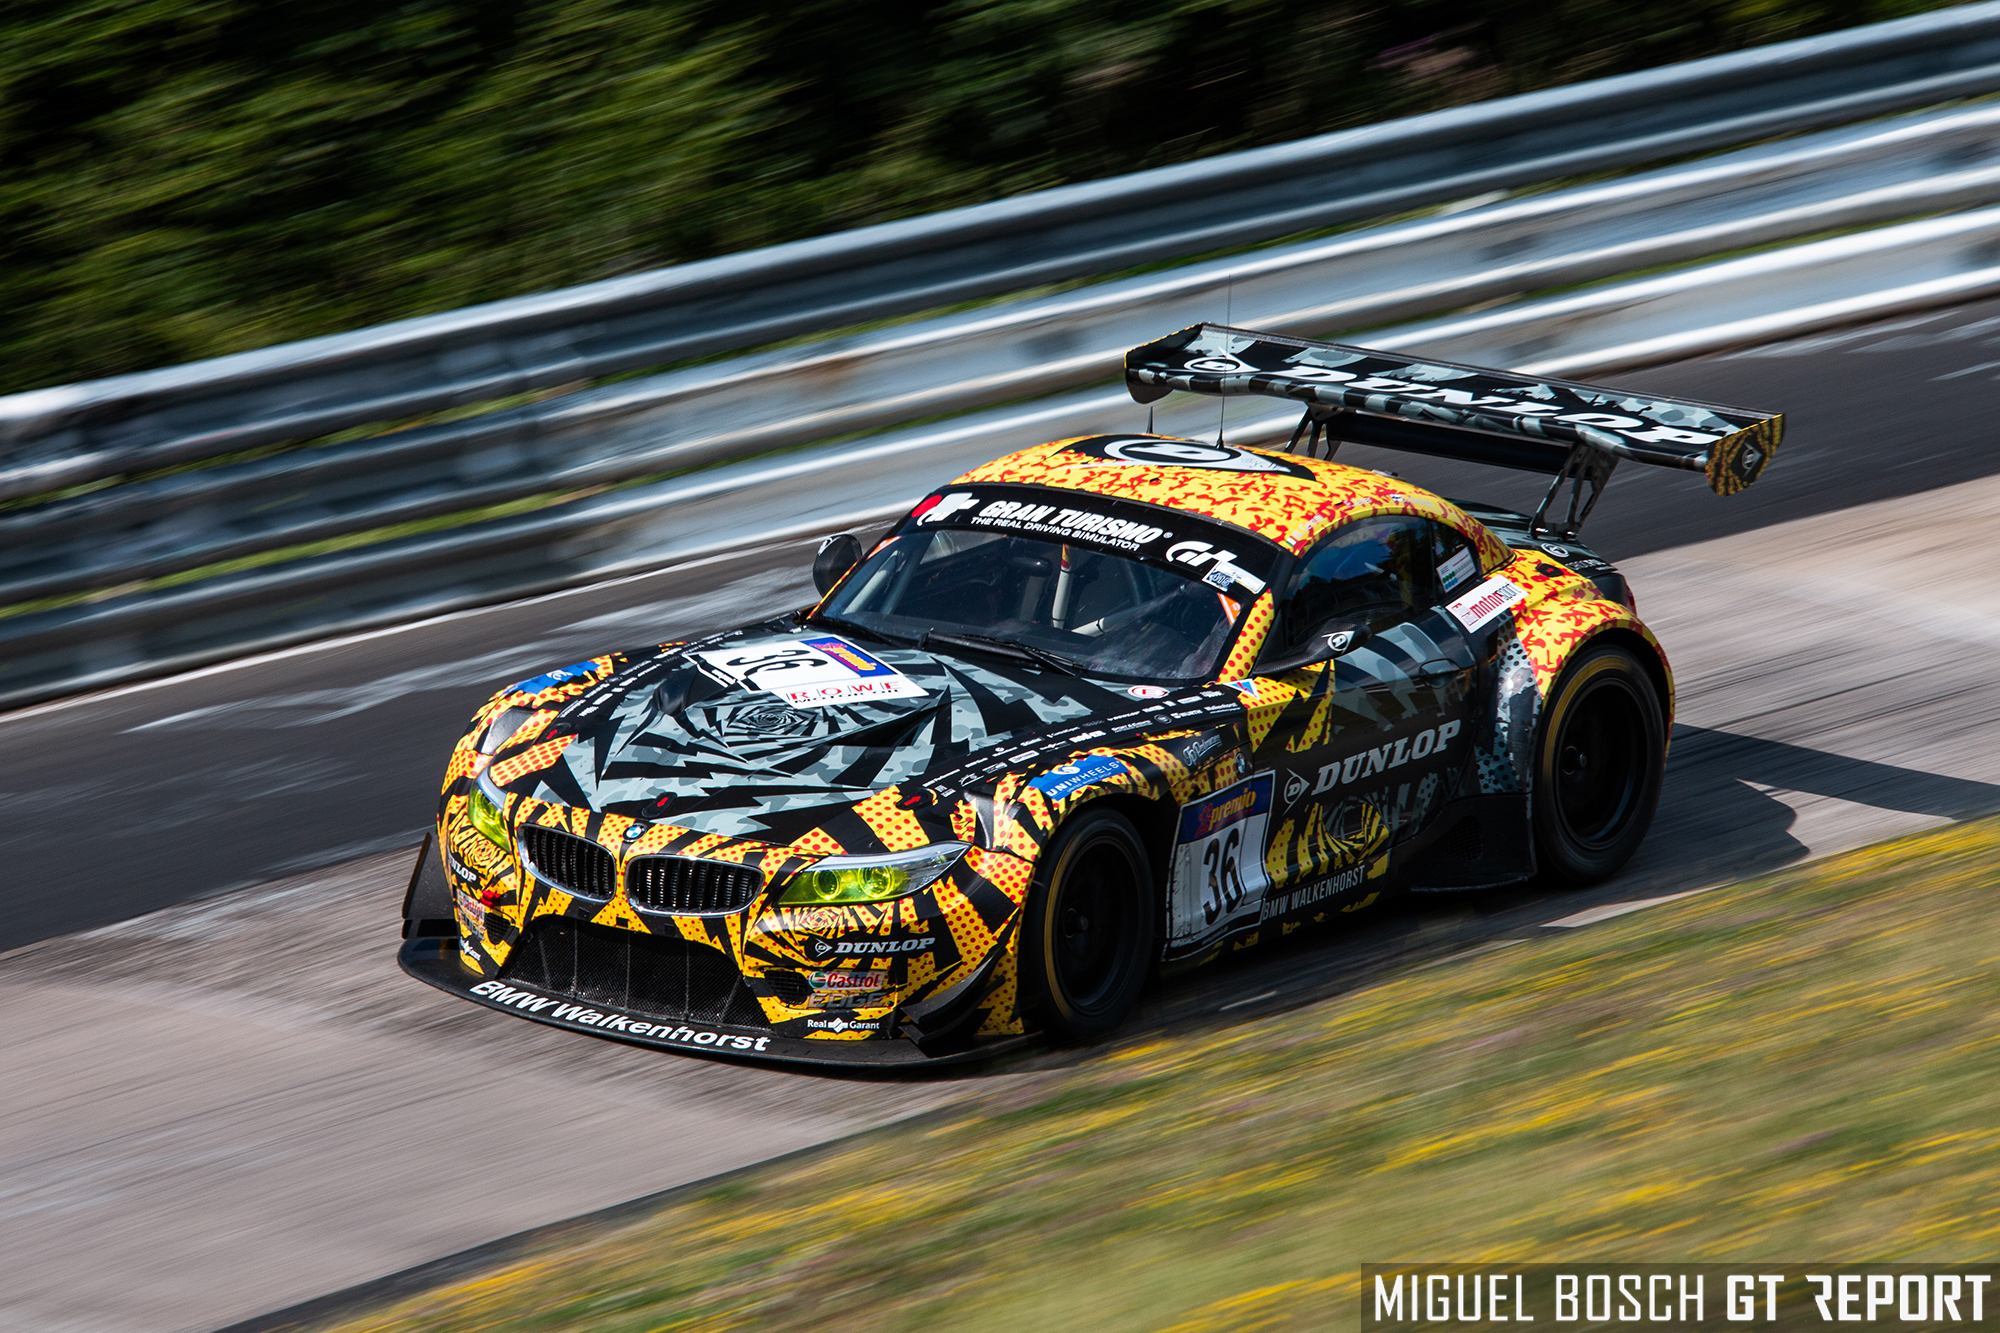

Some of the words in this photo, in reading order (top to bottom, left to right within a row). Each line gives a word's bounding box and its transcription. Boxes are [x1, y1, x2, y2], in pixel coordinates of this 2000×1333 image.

[1266, 364, 1722, 444] DUNLOP
[979, 500, 1056, 523] GRAN
[971, 517, 994, 526] THE
[993, 518, 1022, 529] REAL
[1023, 522, 1072, 537] DRIVING
[1072, 529, 1141, 552] SIMULATOR
[726, 650, 828, 678] 36
[1311, 719, 1461, 796] DUNLOP
[1046, 762, 1118, 796] UNIWHEELS
[1209, 787, 1257, 831] premio
[1203, 828, 1242, 925] 36
[1262, 895, 1289, 921] BMW
[1291, 865, 1365, 910] WALKENHORST
[834, 937, 935, 954] DUNLOP
[827, 973, 880, 988] Castrol
[469, 980, 560, 1012] BMW
[551, 1003, 772, 1051] Walkenhorst
[807, 992, 888, 1008] EDGE
[807, 1019, 827, 1028] Real
[849, 1020, 880, 1029] Garant
